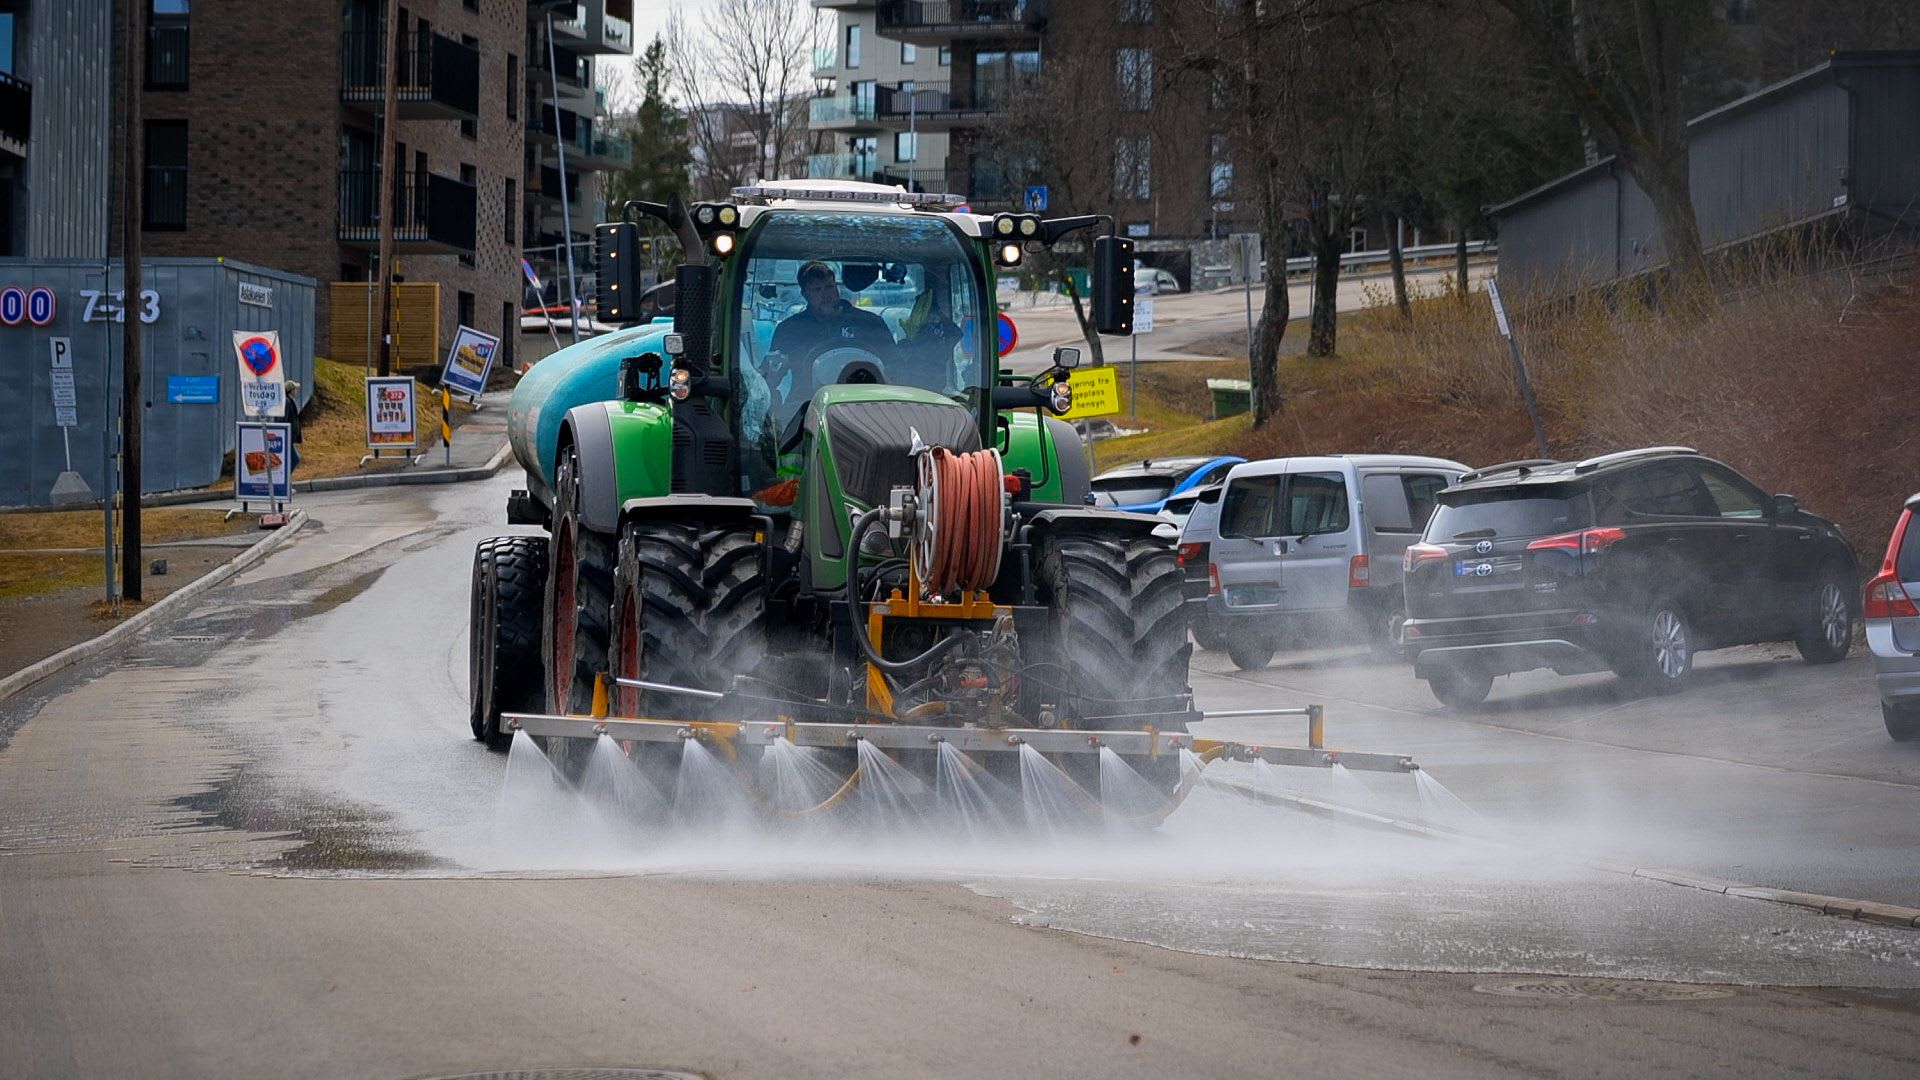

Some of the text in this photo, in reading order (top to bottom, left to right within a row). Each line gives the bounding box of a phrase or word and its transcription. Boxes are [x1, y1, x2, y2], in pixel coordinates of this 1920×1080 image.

[56, 341, 66, 364] P
[1098, 377, 1109, 385] fra
[1072, 389, 1105, 401] geplass
[1076, 400, 1105, 409] hensyn
